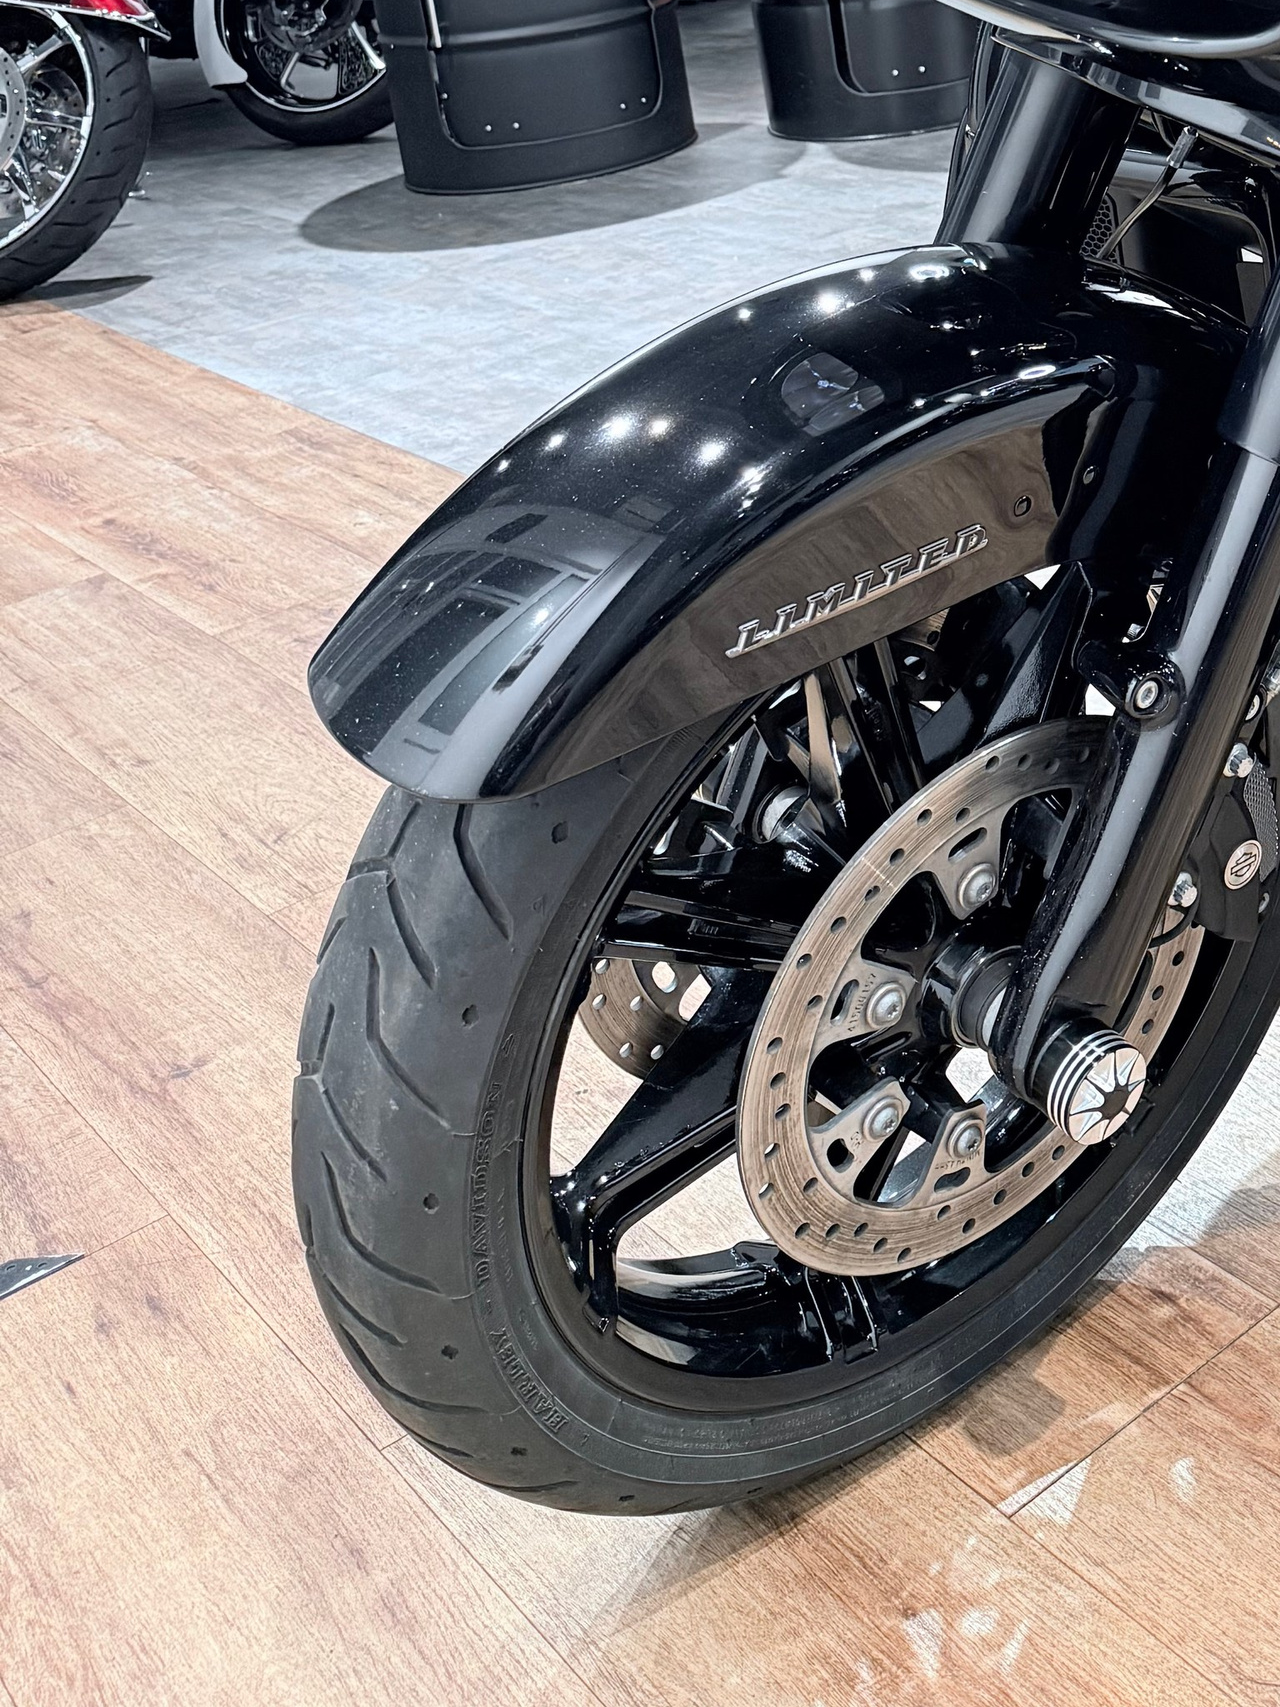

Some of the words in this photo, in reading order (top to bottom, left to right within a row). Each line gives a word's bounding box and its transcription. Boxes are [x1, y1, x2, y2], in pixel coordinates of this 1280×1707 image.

[725, 524, 989, 659] LIMITED
[470, 1082, 502, 1284] DAVIDSON
[489, 1326, 569, 1433] HARLEY
